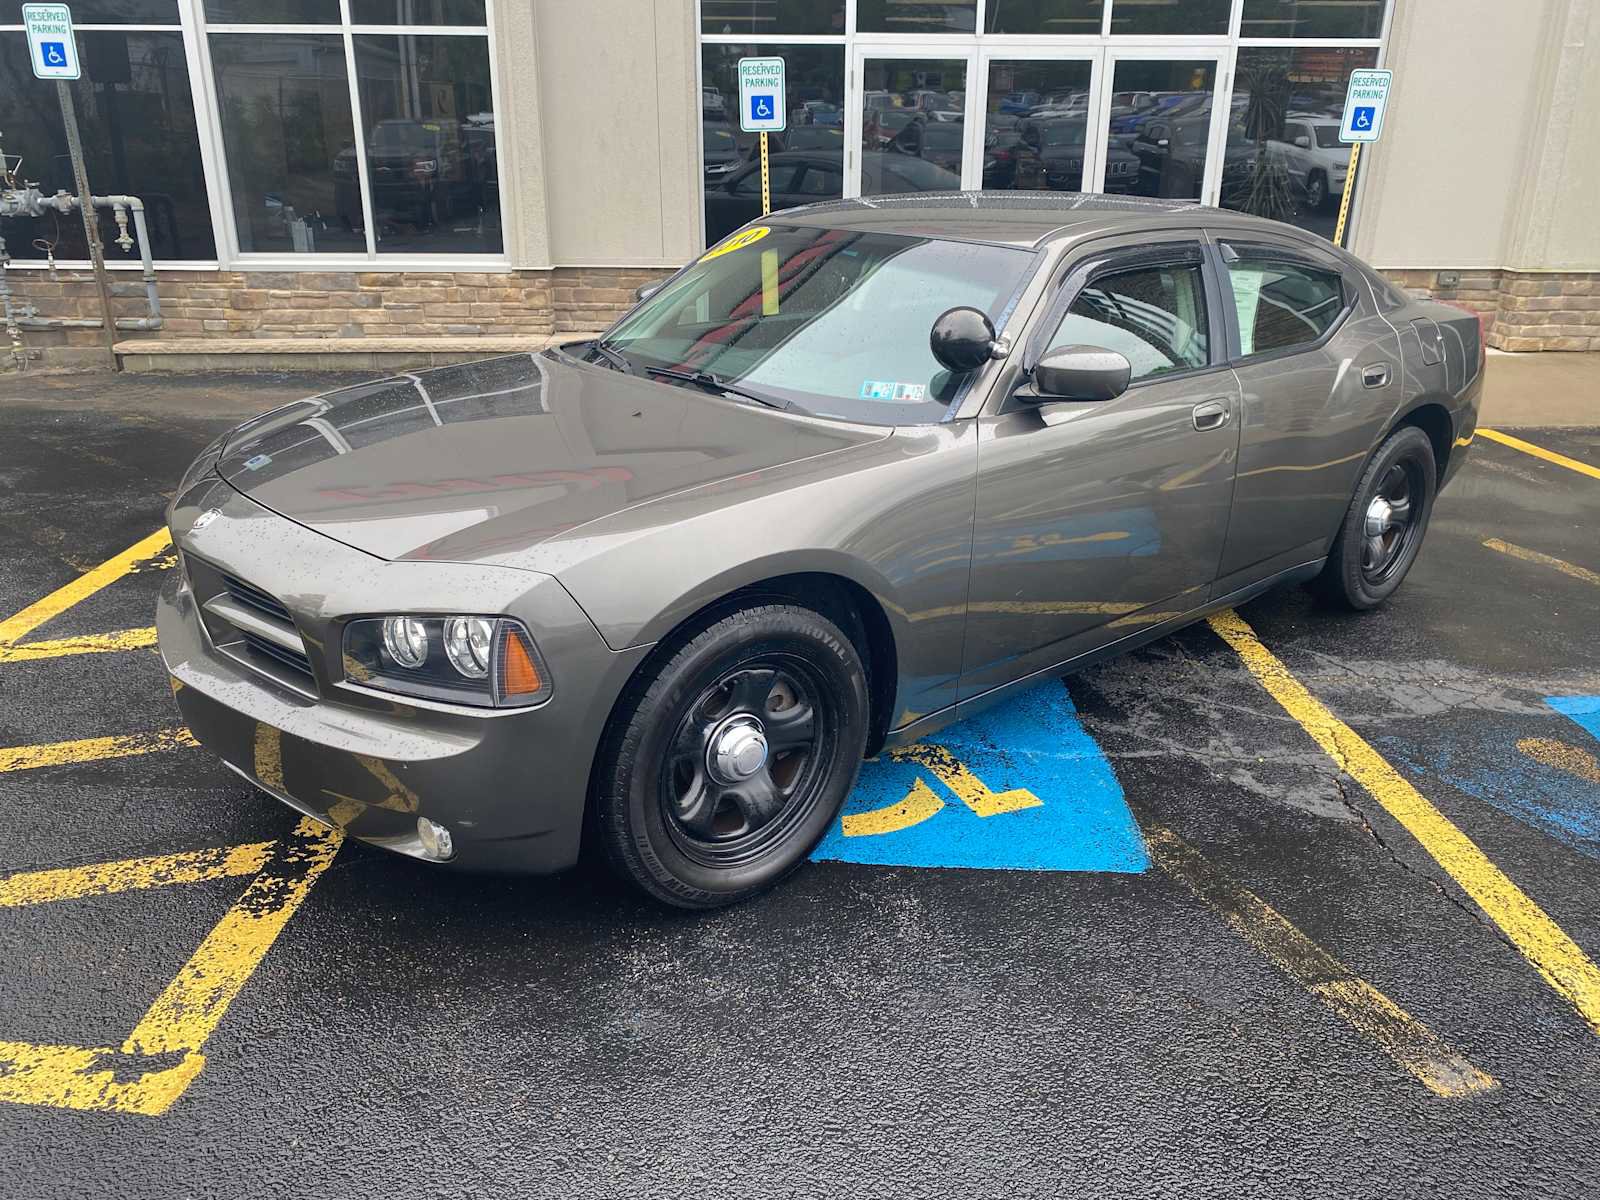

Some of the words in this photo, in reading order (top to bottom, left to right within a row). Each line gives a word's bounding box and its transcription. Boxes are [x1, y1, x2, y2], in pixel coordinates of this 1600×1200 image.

[27, 11, 67, 21] RESERVED
[31, 23, 67, 34] PARKING
[742, 65, 781, 75] RESERVED
[745, 78, 779, 88] PARKING
[1352, 77, 1389, 87] RESERVED
[1352, 89, 1384, 99] PARKING
